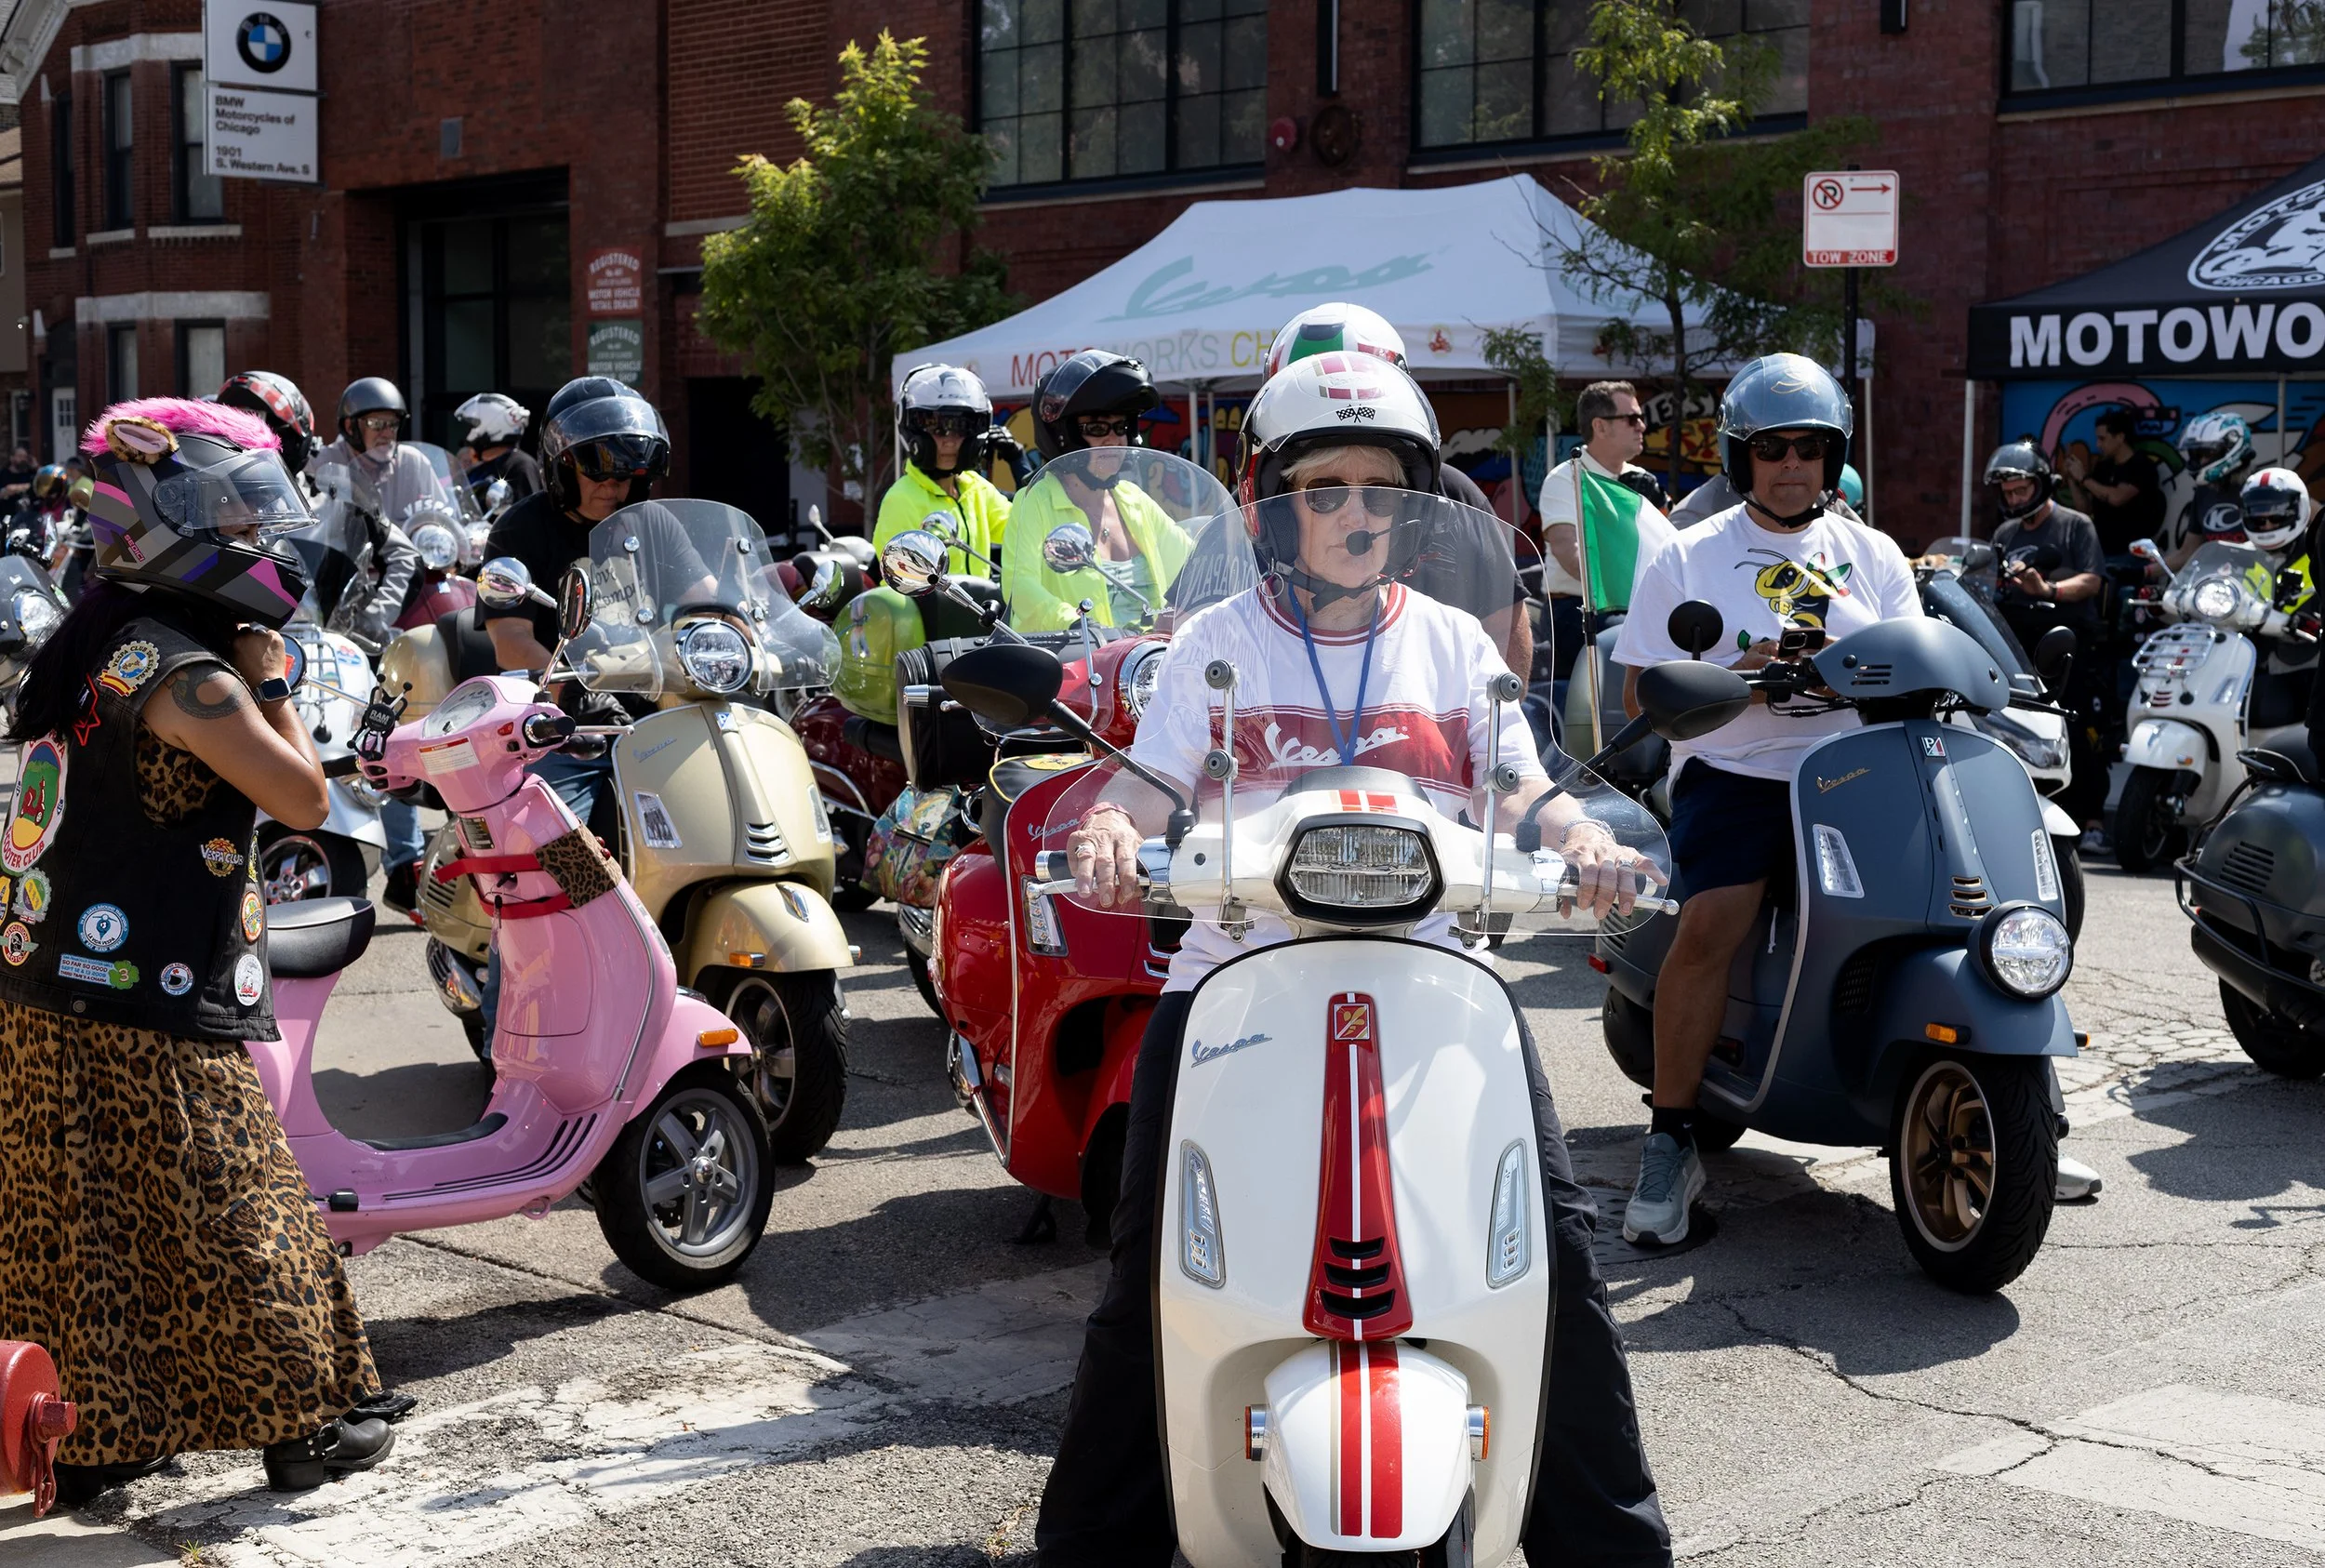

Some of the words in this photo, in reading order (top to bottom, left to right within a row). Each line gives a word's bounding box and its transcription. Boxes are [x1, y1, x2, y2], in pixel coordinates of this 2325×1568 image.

[215, 95, 245, 107] BMW
[215, 108, 282, 124] Motorcycles
[283, 113, 296, 126] of
[215, 120, 261, 136] Chicago
[216, 145, 242, 157] 1901
[215, 157, 227, 168] S.
[229, 158, 274, 172] Western
[276, 162, 299, 175] Ave.
[589, 252, 640, 275] REGISTERED
[1812, 250, 1842, 264] TOW
[1848, 249, 1887, 264] ZONE
[2009, 301, 2325, 368] MOTOWO
[368, 709, 391, 726] RAM
[1816, 767, 1872, 794] Vespa
[1028, 818, 1080, 842] Vespa
[23, 840, 45, 867] CLUB
[200, 844, 224, 863] VESPA
[224, 853, 244, 866] CLUB
[118, 968, 129, 983] 3
[1191, 1033, 1273, 1070] Vespa
